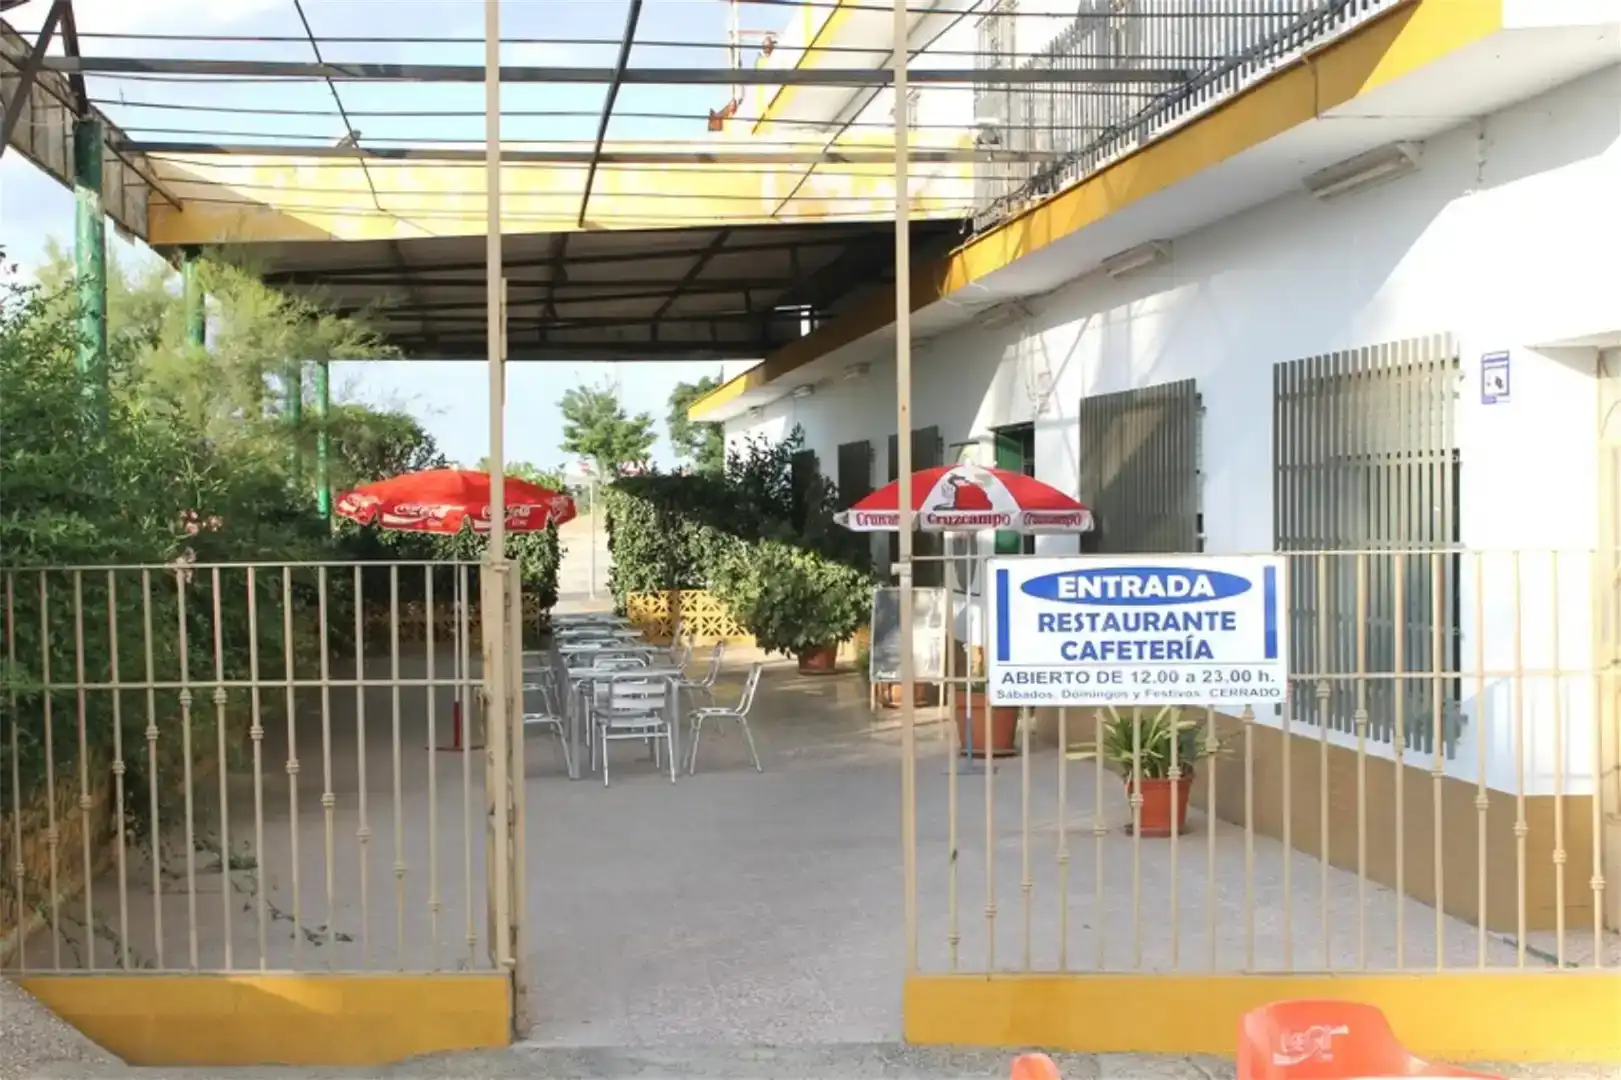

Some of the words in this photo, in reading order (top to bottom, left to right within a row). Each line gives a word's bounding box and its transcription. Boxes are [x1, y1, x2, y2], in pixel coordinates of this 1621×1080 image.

[926, 510, 1011, 527] Cruzcampo
[1056, 575, 1216, 599] ENTRADA
[1037, 611, 1237, 634] RESTAURANTE
[1060, 635, 1215, 662] CAFETERÍA
[1001, 670, 1090, 686] ABIERTO
[1096, 670, 1123, 685] DE
[1130, 669, 1180, 685] 12.00
[1185, 672, 1196, 684] a
[1257, 669, 1276, 683] h.
[1061, 687, 1129, 701] Domingos
[1132, 690, 1141, 700] y
[1208, 686, 1281, 699] CERRADO
